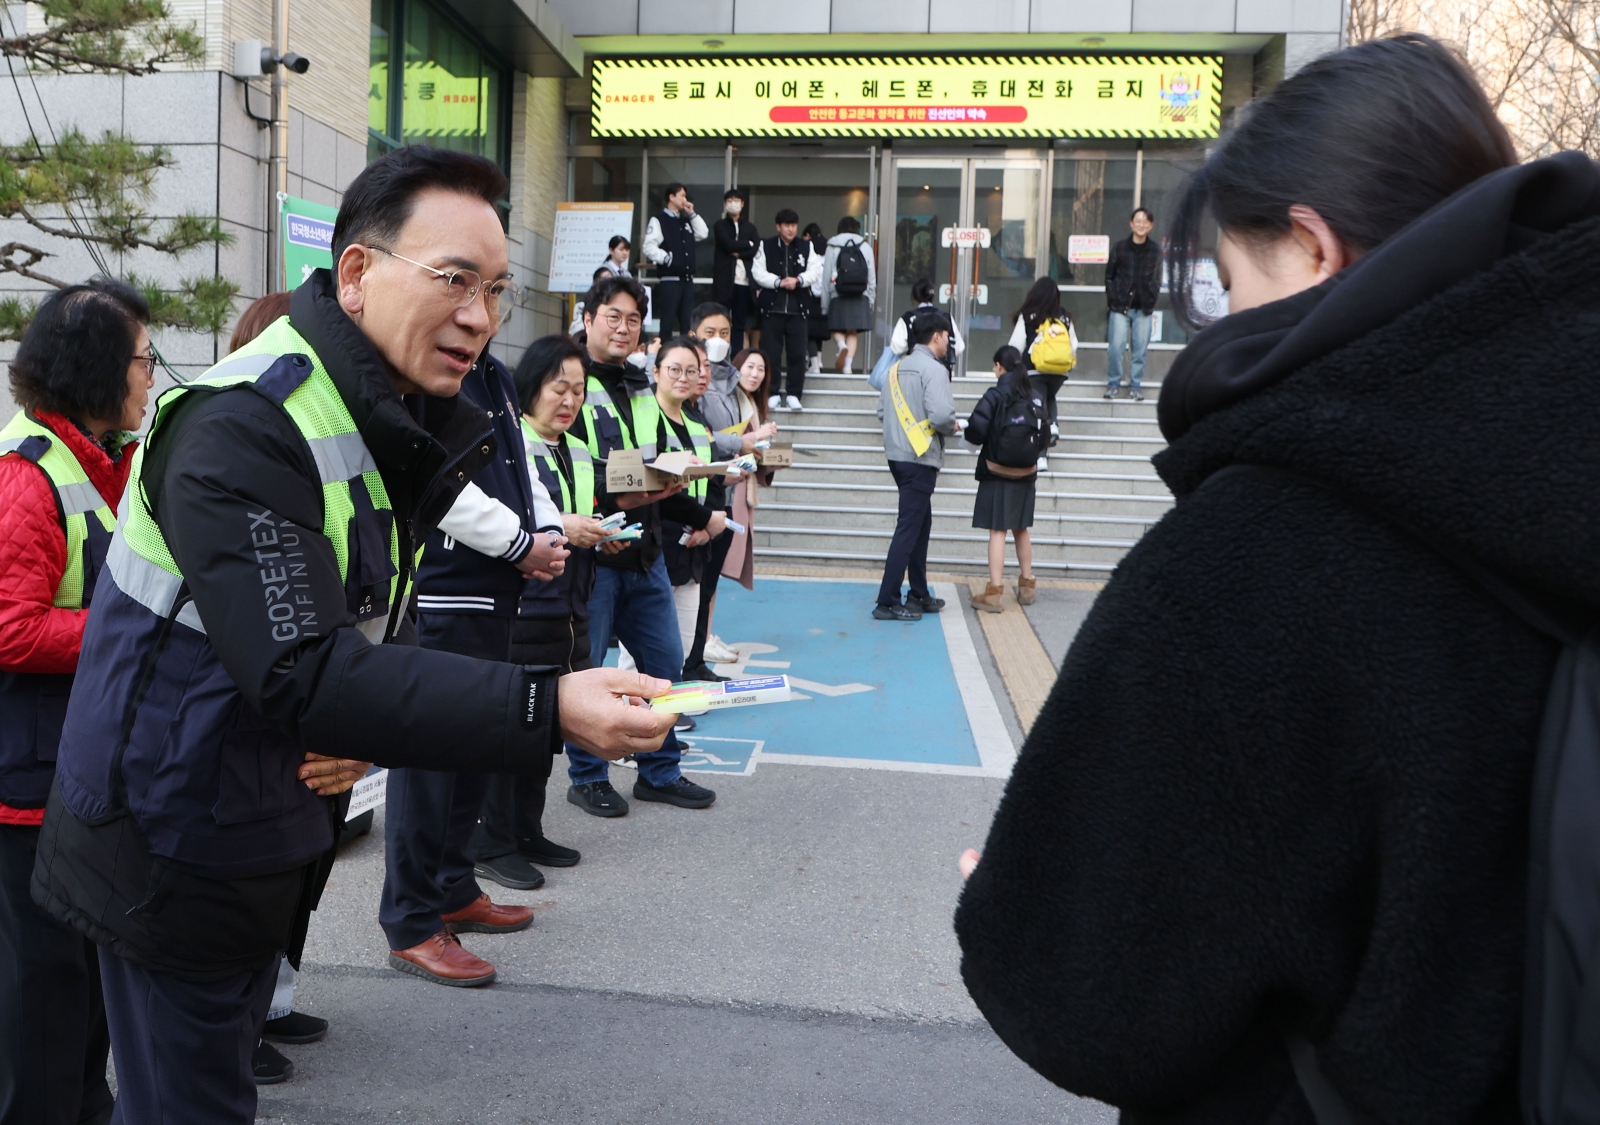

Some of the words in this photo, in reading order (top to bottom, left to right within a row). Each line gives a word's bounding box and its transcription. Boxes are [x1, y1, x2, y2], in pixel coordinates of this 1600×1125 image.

[663, 81, 731, 99] 등교시
[755, 81, 839, 99] 이어폰,
[862, 80, 947, 98] 헤드폰,
[971, 80, 1073, 98] 휴대전화
[1098, 80, 1143, 98] 금지
[605, 95, 656, 103] DANGER
[808, 108, 836, 120] 안전한
[839, 108, 875, 120] 등교문화
[877, 108, 905, 120] 정착을
[907, 108, 926, 120] 위한
[967, 108, 987, 120] 약속
[247, 509, 299, 642] GORE-TEX
[731, 695, 757, 704] 네오라이트
